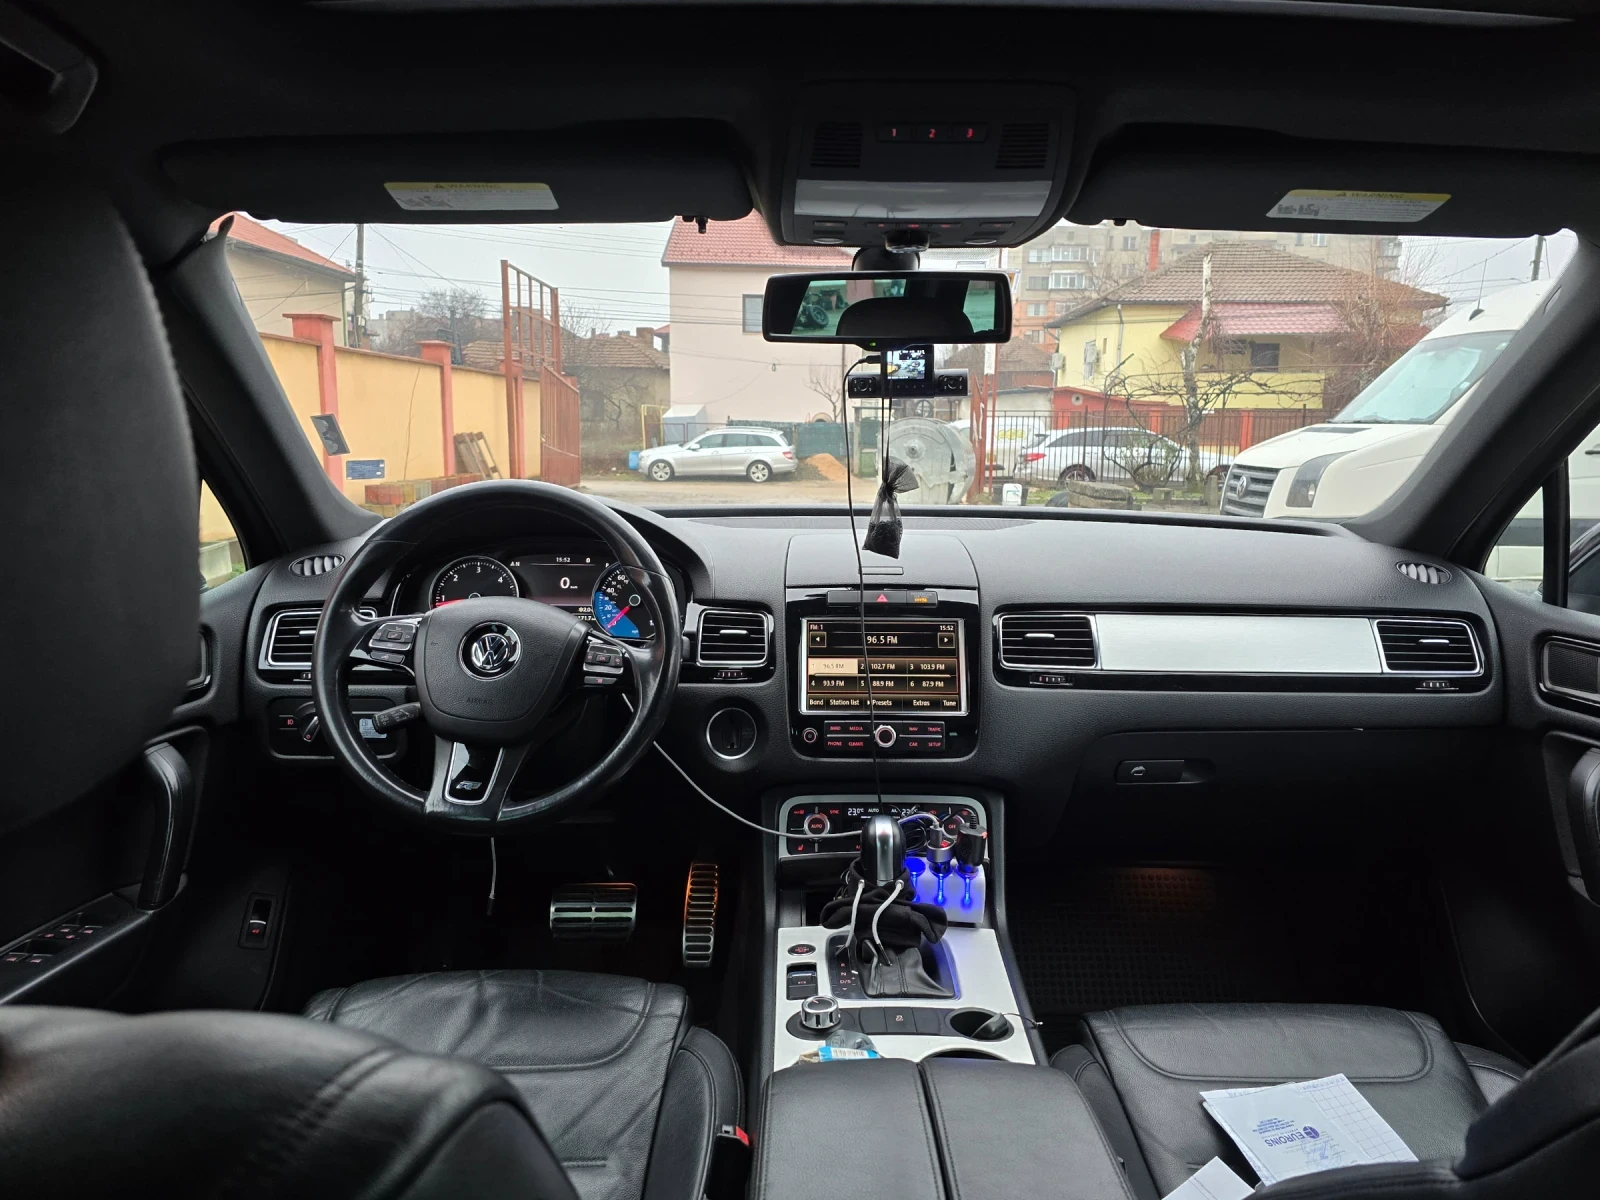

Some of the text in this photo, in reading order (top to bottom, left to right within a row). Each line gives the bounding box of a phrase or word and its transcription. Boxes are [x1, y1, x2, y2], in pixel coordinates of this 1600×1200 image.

[892, 128, 896, 137] 1
[929, 128, 936, 138] 2
[966, 128, 973, 138] 3
[560, 577, 570, 588] 0
[867, 636, 898, 644] 96.5 FM
[1264, 1132, 1305, 1146] EUROINS
